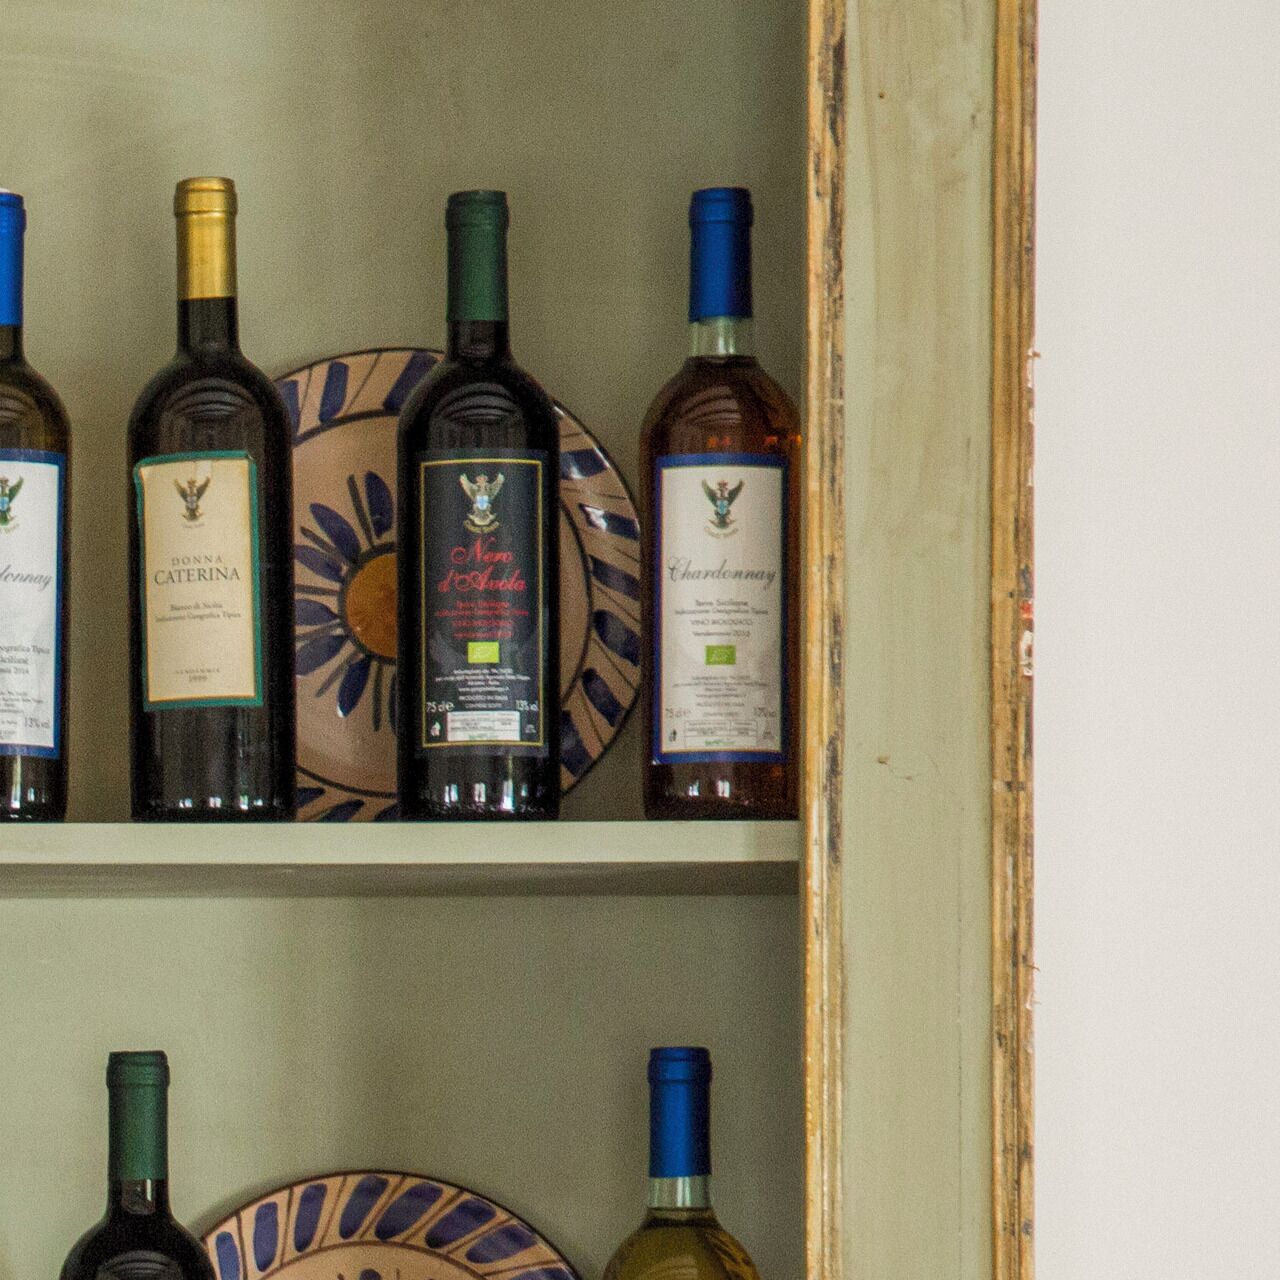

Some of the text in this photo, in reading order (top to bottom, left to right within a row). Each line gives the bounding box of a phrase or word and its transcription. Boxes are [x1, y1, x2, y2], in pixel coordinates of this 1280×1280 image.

[171, 554, 224, 566] DONNA
[451, 537, 513, 564] Nero
[154, 567, 241, 585] CATERINA
[667, 556, 777, 590] Chardonnay
